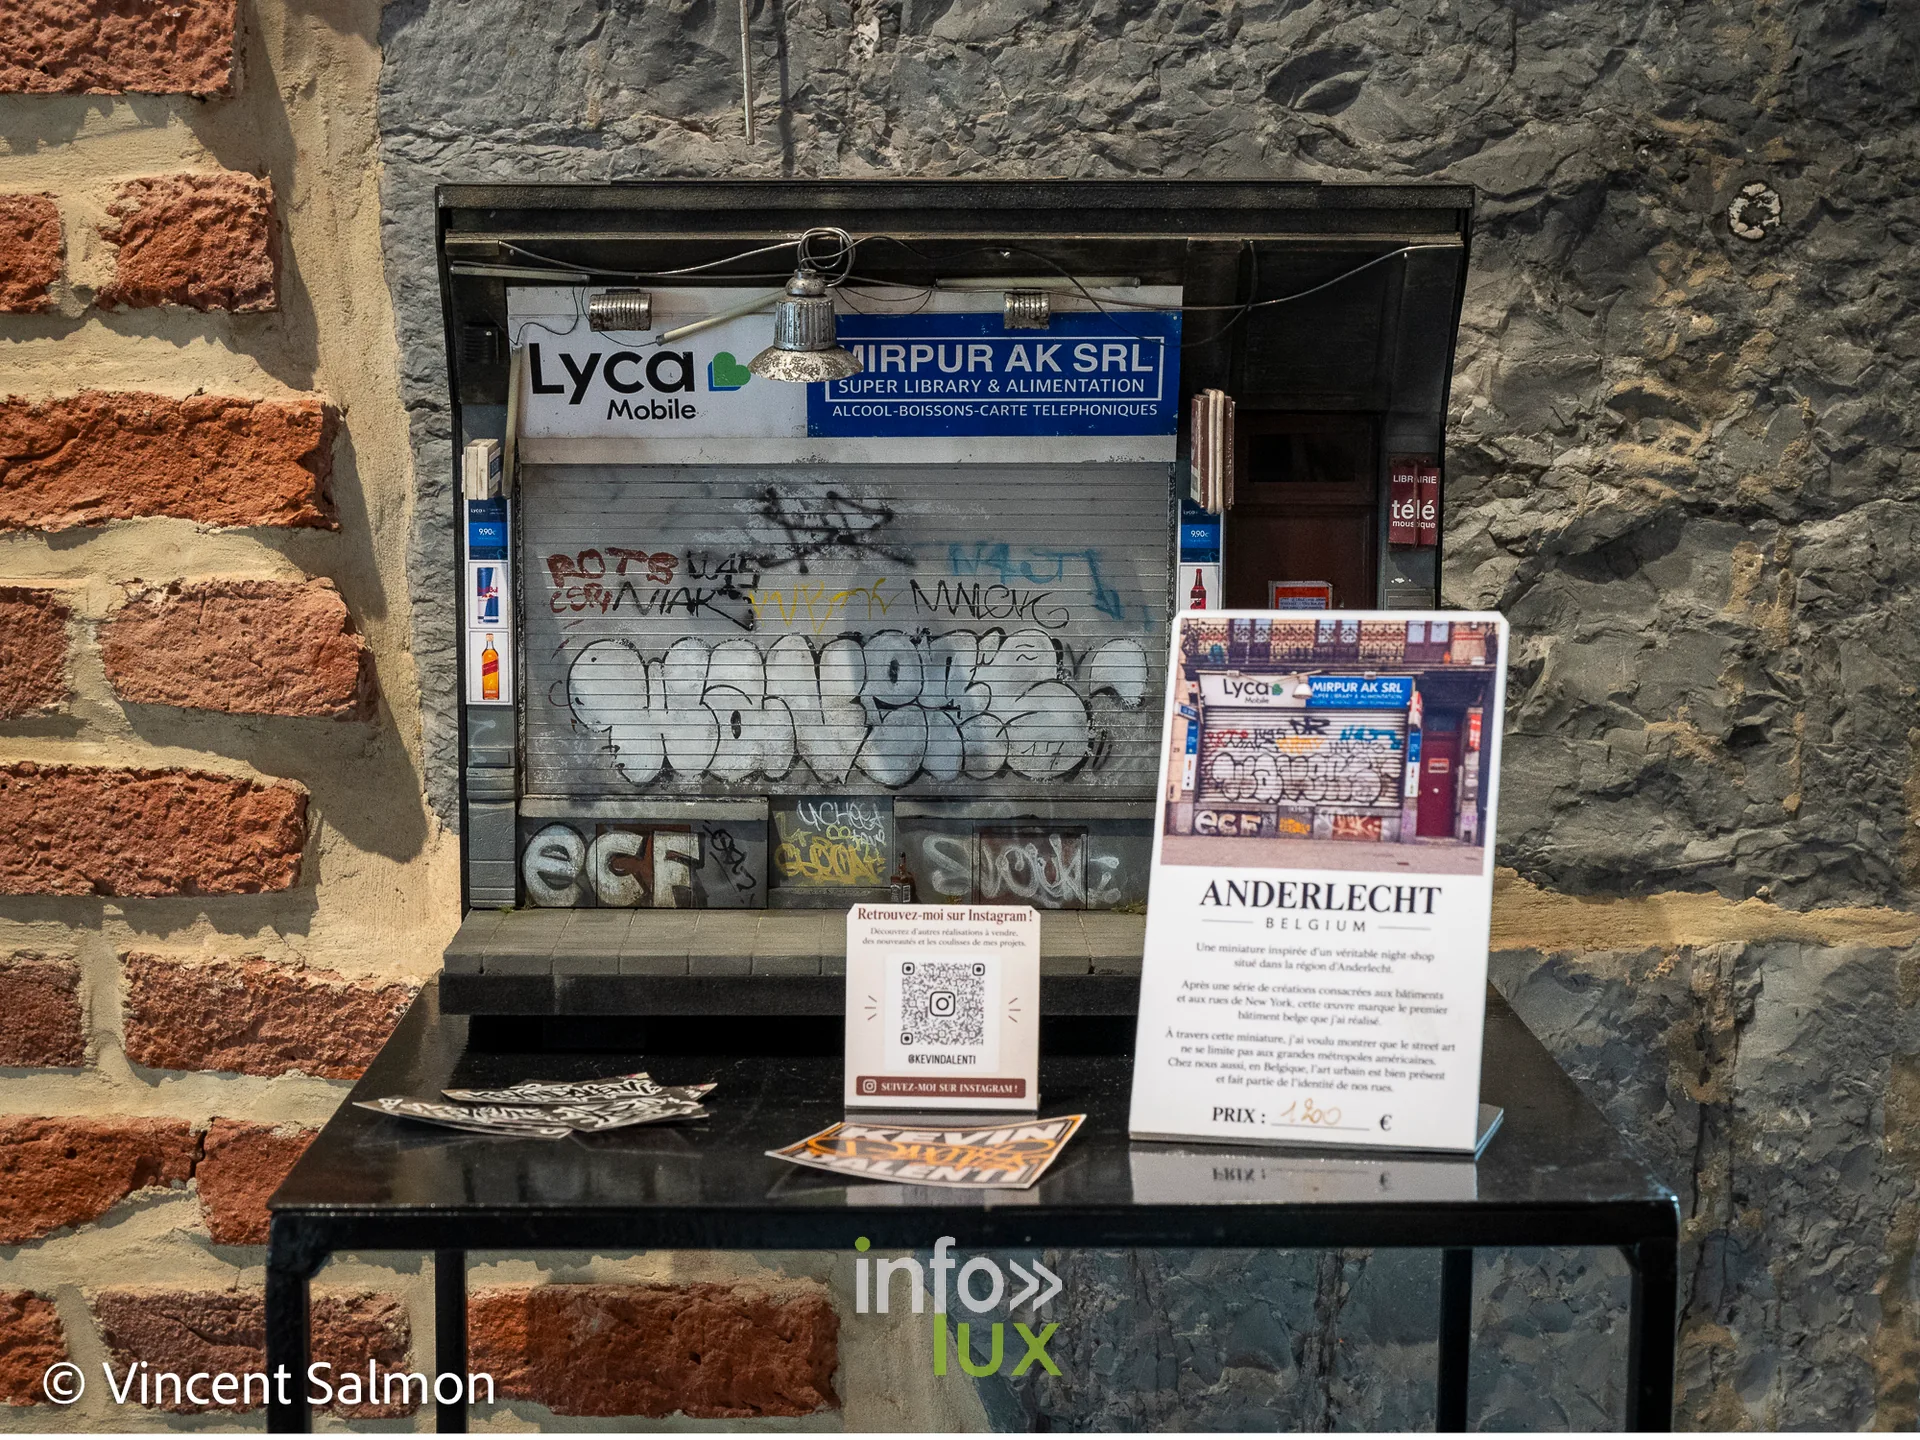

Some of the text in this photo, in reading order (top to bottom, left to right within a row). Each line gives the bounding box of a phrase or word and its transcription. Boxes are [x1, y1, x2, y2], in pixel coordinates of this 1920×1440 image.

[1004, 344, 1062, 372] AK
[1073, 343, 1154, 372] SRL
[529, 343, 696, 404] Lyca
[838, 378, 1145, 394] SUPER LIBRARY & ALIMENTATION
[606, 398, 696, 420] Mobile
[832, 404, 1158, 417] ALCOOL-BOISSONS-CARTE TELEPHONIQUES
[1391, 498, 1435, 520] télé
[1223, 678, 1270, 698] Lyca
[1312, 681, 1403, 694] MIRPUR AK SRL
[1199, 880, 1443, 914] ANDERLECHT
[858, 907, 944, 921] Retrouvez-moi
[946, 911, 965, 921] sur
[870, 927, 910, 936] Découvrez
[942, 928, 983, 937] réalisations
[1266, 917, 1366, 932] BELGIUM
[862, 937, 875, 945] des
[876, 938, 916, 946] nouveautés
[927, 938, 937, 946] les
[938, 938, 970, 947] coulisses
[972, 939, 981, 947] de
[1196, 942, 1216, 952] Une
[1218, 944, 1265, 954] miniature
[1268, 945, 1307, 957] inspirée
[1336, 948, 1378, 959] véritable
[1234, 958, 1257, 968] situé
[1259, 959, 1282, 969] dans
[1284, 960, 1294, 969] la
[1296, 961, 1327, 973] région
[1182, 980, 1210, 991] Après
[1233, 982, 1256, 992] série
[1258, 983, 1270, 993] de
[1272, 984, 1316, 995] créations
[1318, 987, 1372, 997] consacrées
[1374, 990, 1393, 998] aux
[1395, 989, 1444, 1000] bâtiments
[1177, 994, 1186, 1003] et
[1188, 995, 1206, 1003] aux
[1208, 996, 1229, 1004] rues
[1231, 996, 1243, 1005] de
[1245, 997, 1267, 1006] New
[1297, 999, 1321, 1009] cette
[1358, 1003, 1396, 1014] marque
[1398, 1003, 1408, 1013] le
[1409, 1005, 1448, 1015] premier
[1238, 1010, 1281, 1021] bâtiment
[1283, 1012, 1308, 1024] belge
[1310, 1015, 1328, 1025] que
[1164, 1026, 1174, 1039] À
[1176, 1030, 1209, 1040] travers
[1211, 1031, 1235, 1041] cette
[1307, 1036, 1335, 1046] voulu
[1337, 1038, 1378, 1048] montrer
[1380, 1041, 1398, 1051] que
[1400, 1040, 1409, 1050] le
[1411, 1041, 1439, 1051] street
[1441, 1043, 1456, 1052] art
[908, 1054, 977, 1065] @KEVINDALENTI
[1181, 1045, 1192, 1053] ne
[1195, 1046, 1205, 1054] se
[1207, 1045, 1235, 1056] limite
[1237, 1049, 1254, 1058] pas
[1256, 1049, 1274, 1057] aux
[1276, 1049, 1315, 1060] grandes
[1318, 1052, 1372, 1063] métropoles
[1168, 1056, 1192, 1067] Chez
[1195, 1061, 1218, 1069] nous
[1333, 1065, 1366, 1076] urbain
[1368, 1068, 1382, 1077] est
[1384, 1068, 1406, 1078] bien
[1408, 1070, 1445, 1081] présent
[881, 1082, 937, 1093] SUIVEZ-MOI
[939, 1084, 957, 1093] SUR
[1216, 1075, 1225, 1084] et
[1227, 1075, 1243, 1085] fait
[1246, 1076, 1275, 1088] partie
[1277, 1077, 1289, 1087] de
[1336, 1080, 1348, 1090] de
[1351, 1083, 1369, 1091] nos
[1212, 1106, 1256, 1124] PRIX
[1379, 1114, 1393, 1132] €
